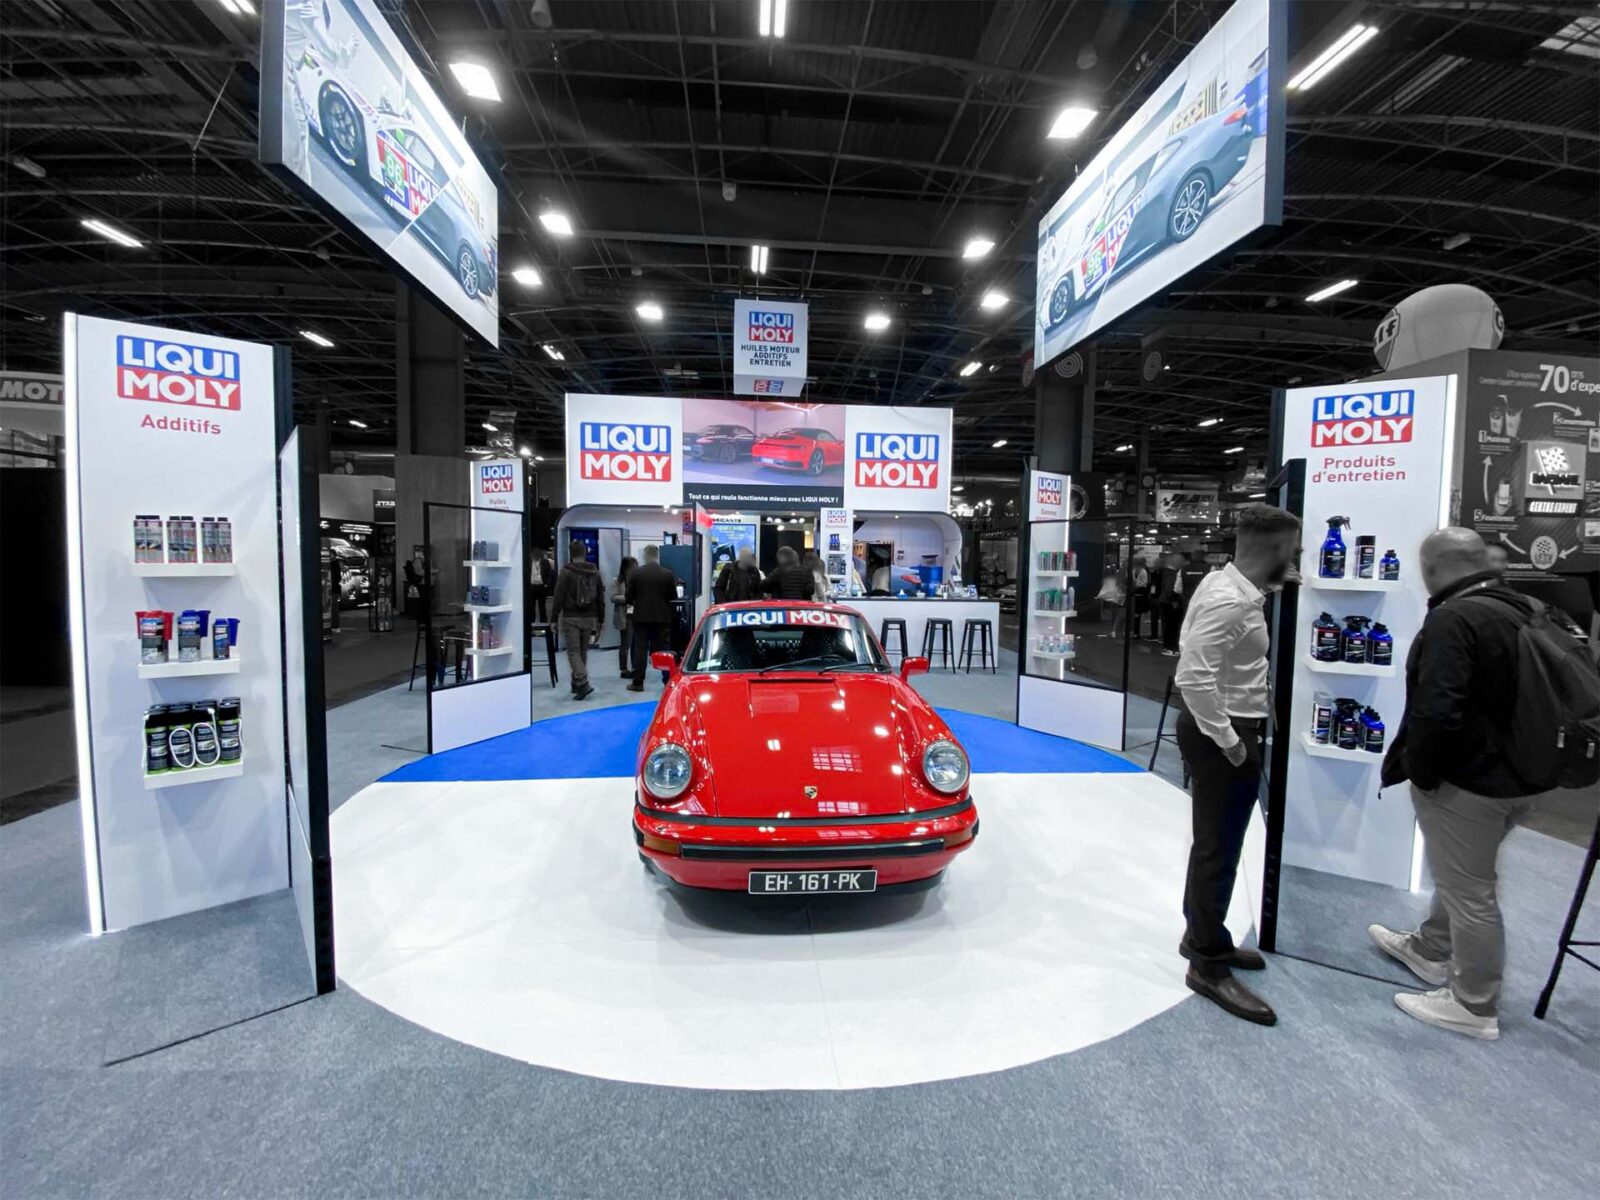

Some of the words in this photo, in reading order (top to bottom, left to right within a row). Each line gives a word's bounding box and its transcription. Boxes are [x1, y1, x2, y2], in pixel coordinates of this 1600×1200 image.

[751, 313, 792, 328] LIQUI
[750, 327, 793, 343] MOLY
[741, 344, 768, 352] HUILES
[769, 345, 800, 354] MOTEUR
[753, 352, 788, 360] ADDITIFS
[122, 338, 236, 379] LIQUI
[749, 359, 791, 367] ENTRETIEN
[1540, 364, 1570, 393] 70
[123, 369, 239, 408] MOLY
[1317, 392, 1410, 420] LIQUI
[140, 414, 222, 435] Additifs
[1315, 417, 1412, 446] MOLY
[584, 424, 668, 453] LIQUI
[860, 434, 936, 461] LIQUI
[584, 453, 671, 480] MOLY
[1324, 455, 1396, 469] Produits
[482, 465, 512, 478] LIQUI
[859, 461, 938, 487] MOLY
[1312, 469, 1406, 483] d'entretien
[483, 478, 513, 492] MOLY
[1039, 478, 1061, 491] LIQUI
[1039, 490, 1061, 504] MOLY
[726, 611, 784, 627] LIQUI
[789, 610, 847, 628] MOLY
